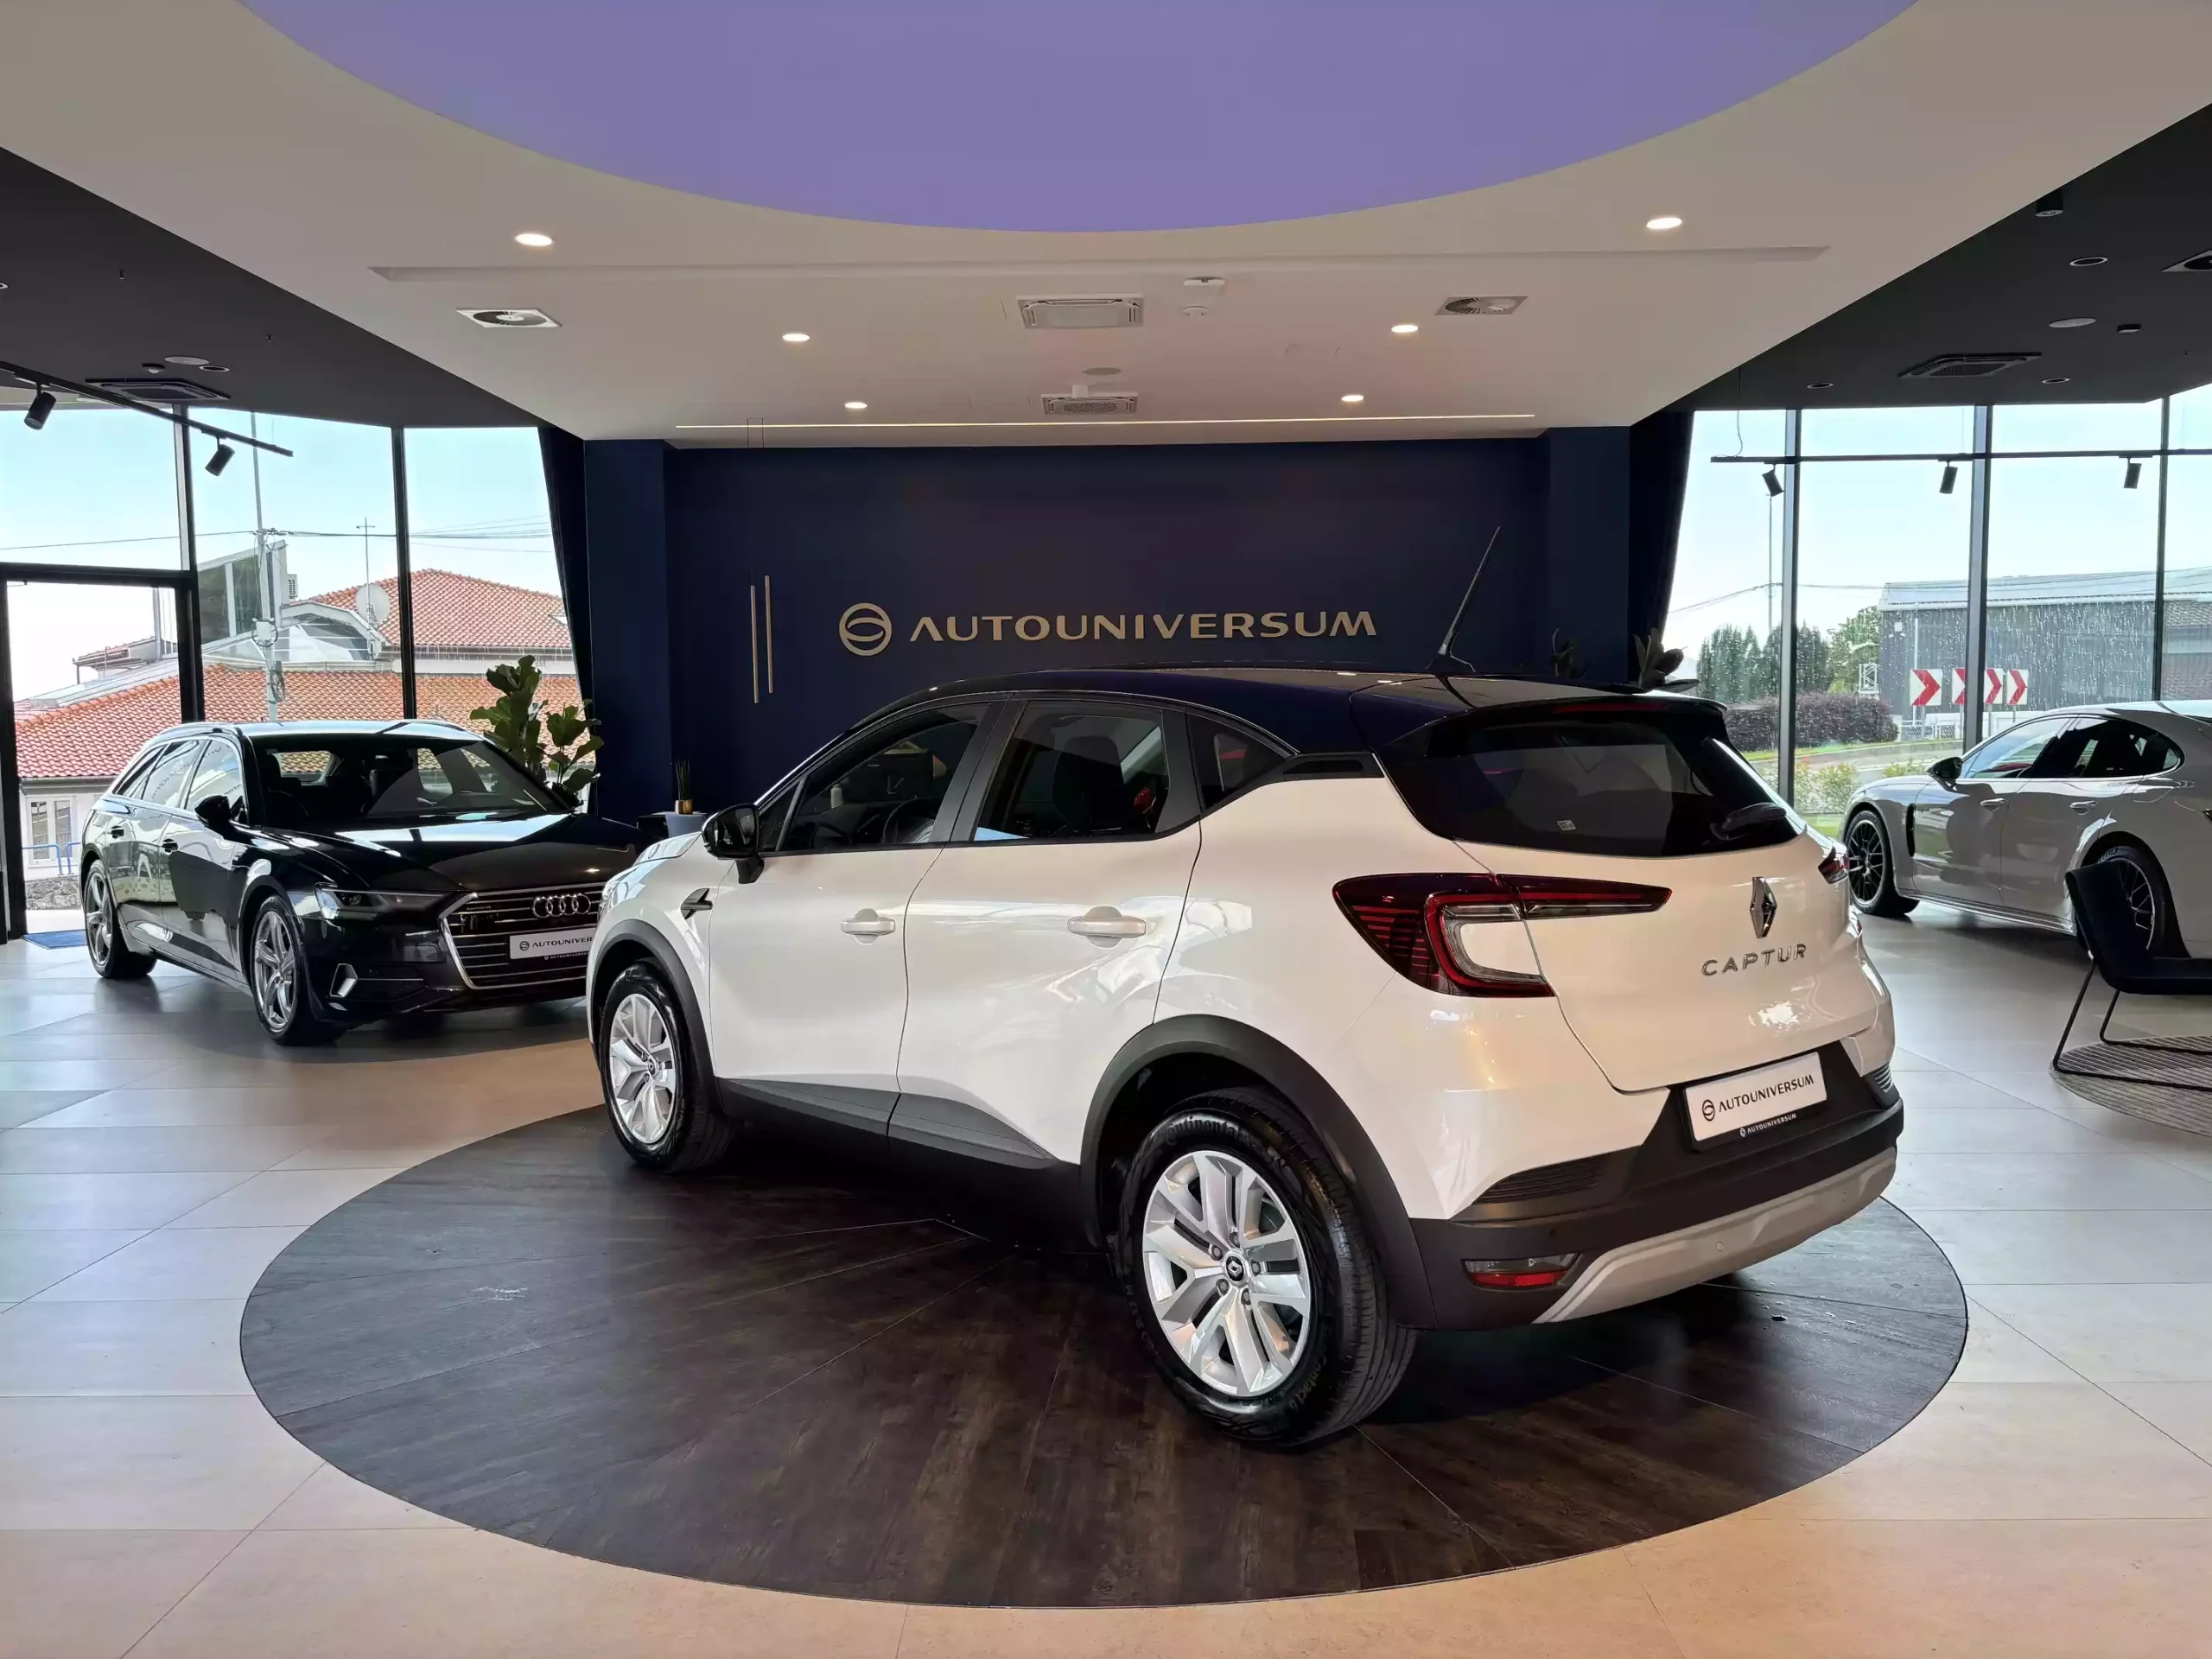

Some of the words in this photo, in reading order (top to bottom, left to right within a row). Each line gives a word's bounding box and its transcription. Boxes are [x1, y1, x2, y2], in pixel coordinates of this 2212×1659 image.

[910, 611, 1376, 641] AUTOUNIVERSUM
[532, 936, 593, 948] AUTOUNIVER
[1701, 943, 1807, 976] CAPTUR
[1719, 1074, 1815, 1113] AUTOUNIVERSUM
[1747, 1113, 1796, 1134] AUTOUNIVERSUM
